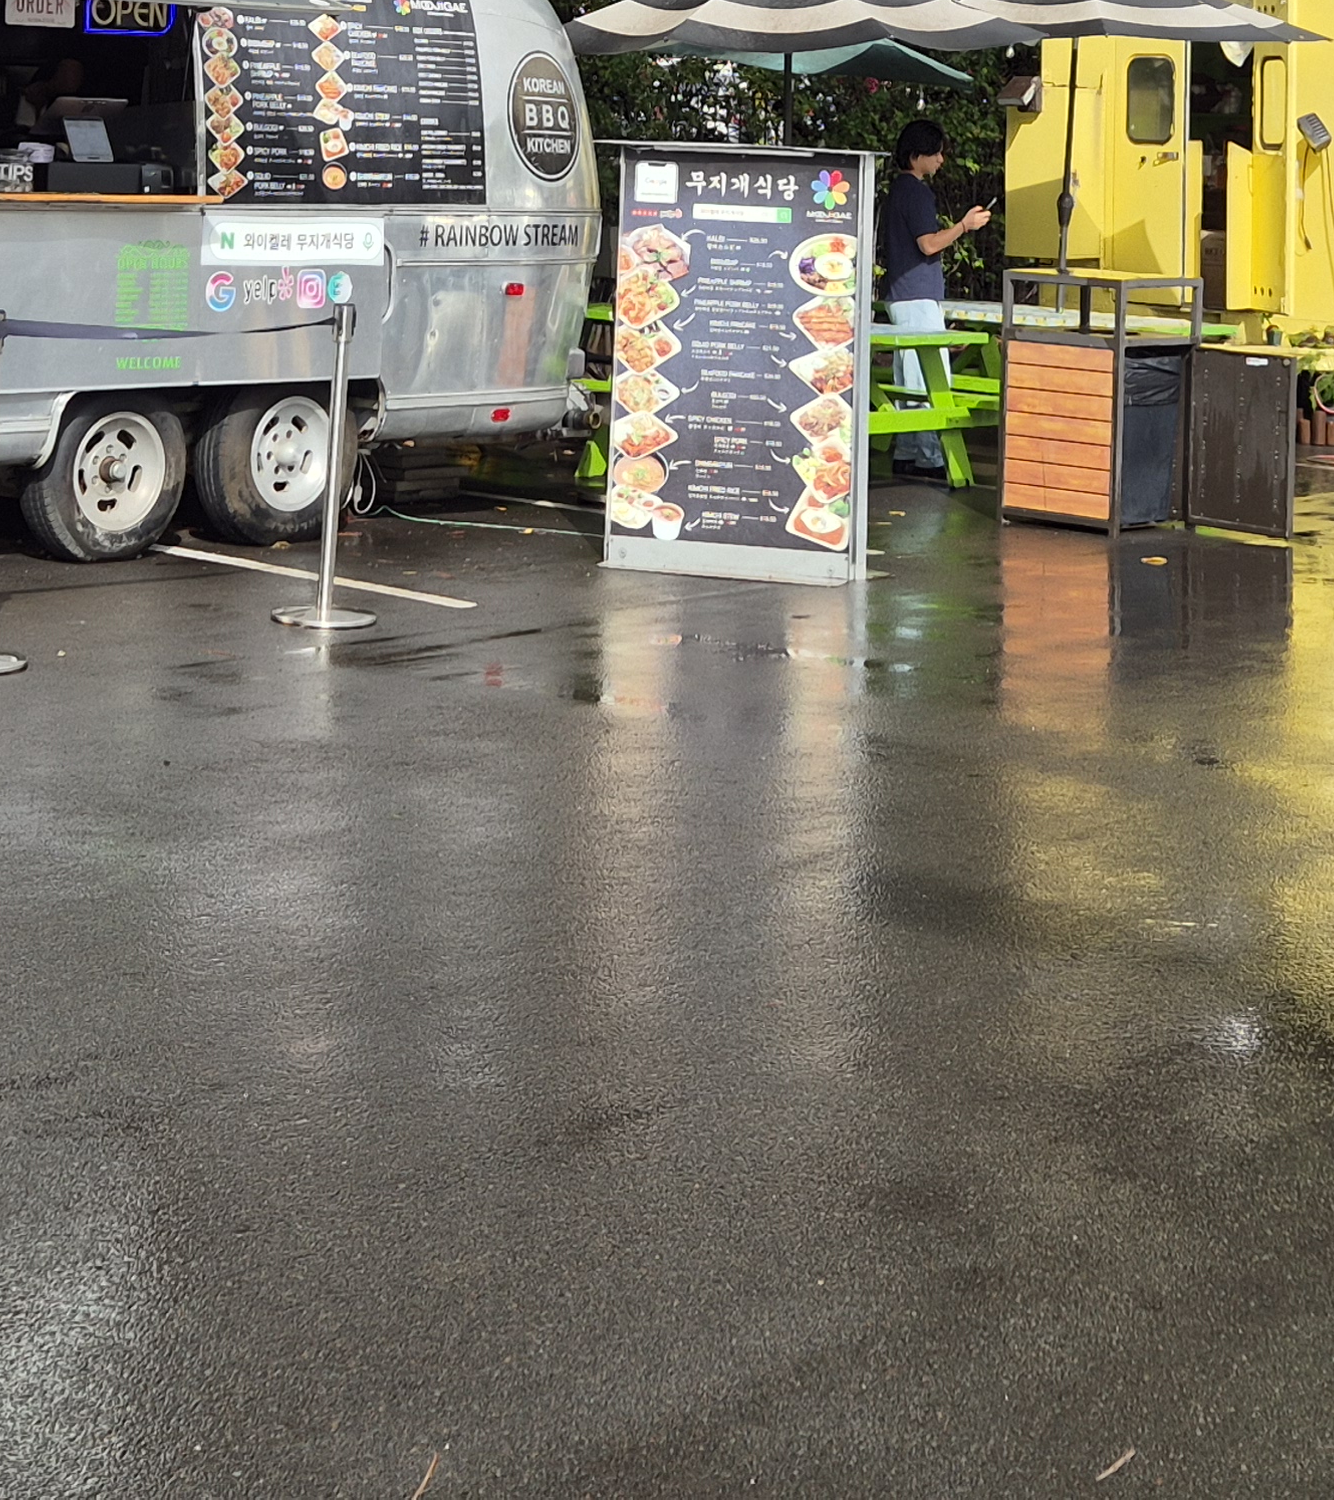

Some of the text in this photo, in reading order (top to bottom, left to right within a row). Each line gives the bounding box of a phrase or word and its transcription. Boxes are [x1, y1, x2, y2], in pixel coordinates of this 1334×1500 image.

[523, 77, 565, 95] KOREAN
[524, 102, 571, 129] BBQ
[526, 136, 571, 154] KITCHEN
[685, 169, 800, 201] 무지개식당
[296, 233, 355, 250] 무지개식당
[434, 224, 519, 248] RAINBOW
[523, 223, 579, 248] STREAM
[243, 274, 280, 306] yelp
[116, 356, 182, 370] WELCOME
